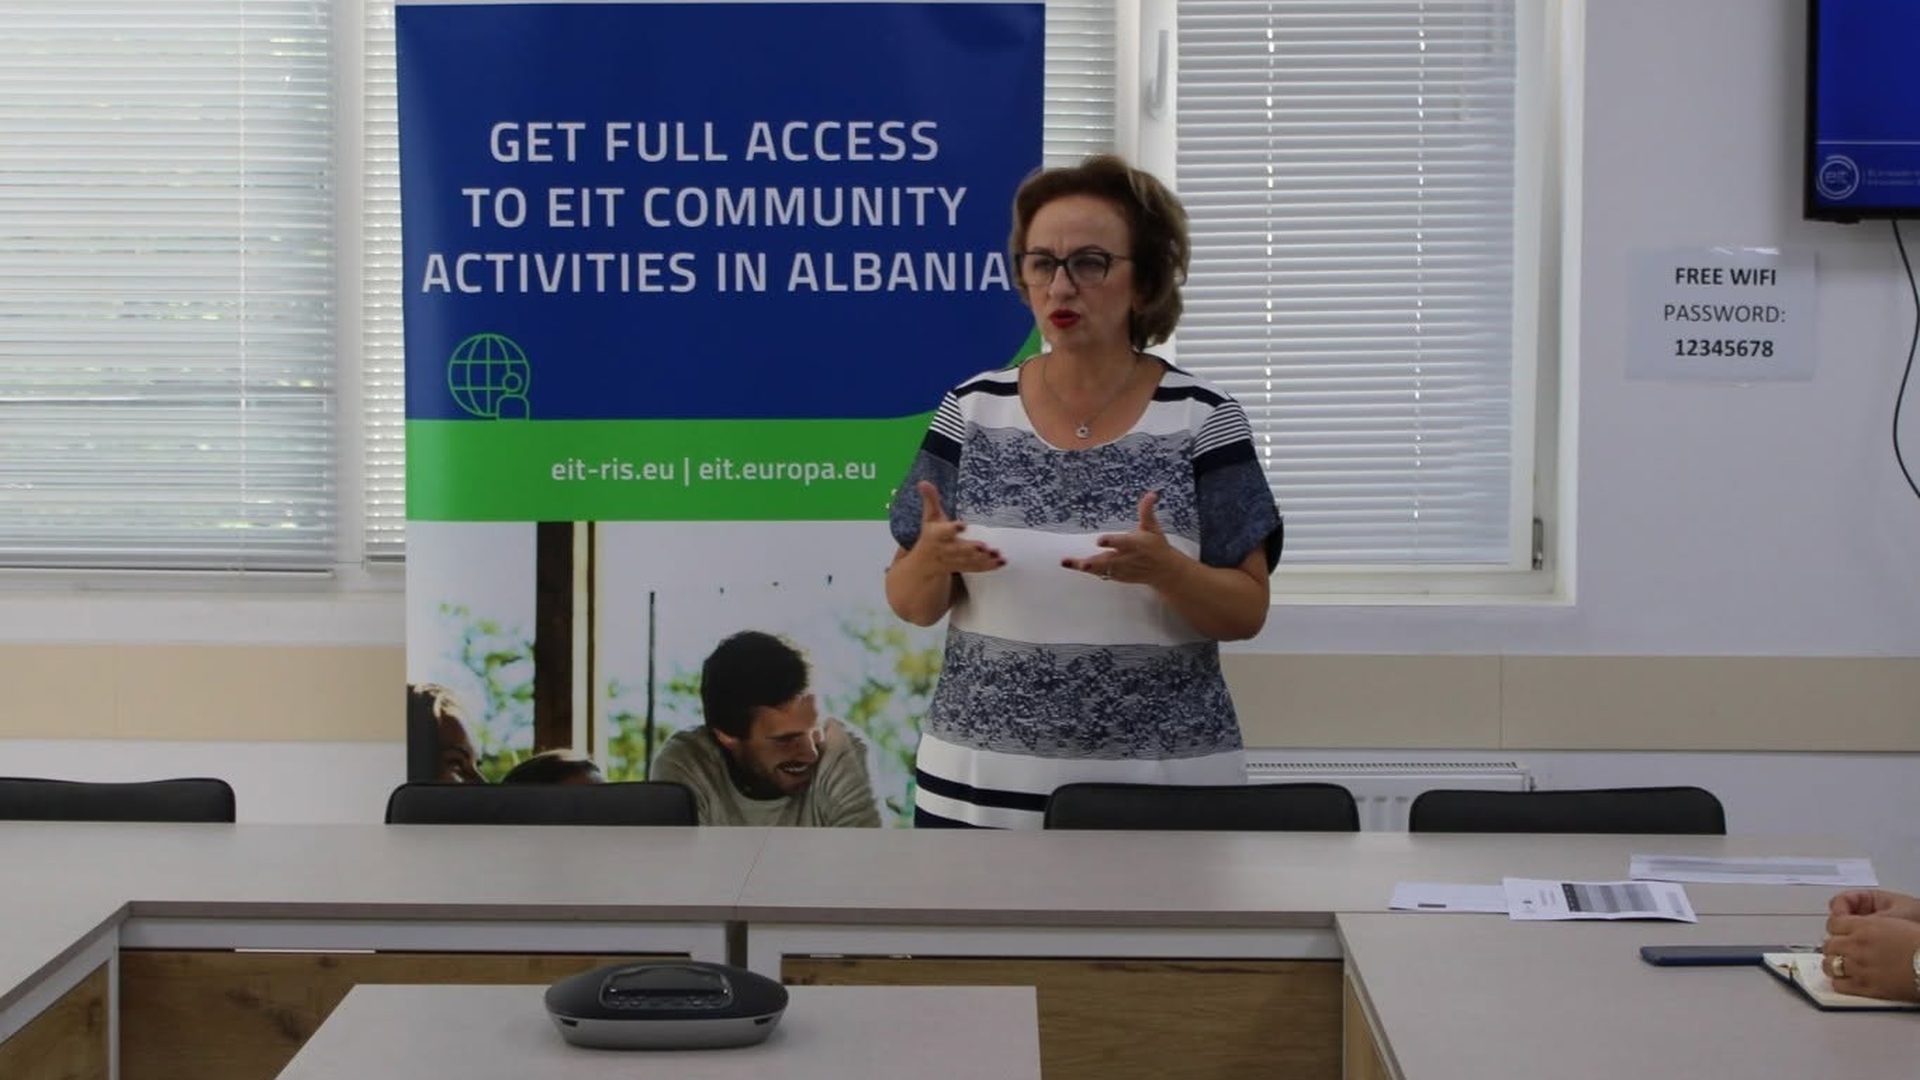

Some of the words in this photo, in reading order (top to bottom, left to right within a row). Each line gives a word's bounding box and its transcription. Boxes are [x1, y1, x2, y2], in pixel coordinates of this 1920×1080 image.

[490, 122, 586, 163] GET
[606, 122, 728, 162] FULL
[746, 121, 938, 162] ACCESS
[462, 187, 527, 228] TO
[548, 187, 625, 227] EIT
[644, 186, 967, 227] COMMUNITY
[421, 252, 696, 293] ACTIVITIES
[718, 252, 766, 292] IN
[788, 252, 1010, 292] ALBANIA
[1675, 267, 1723, 286] FREE
[1730, 268, 1777, 287] WIFI
[1664, 304, 1786, 324] PASSWORD:
[1675, 338, 1774, 358] 12345678
[551, 458, 674, 481] eit-ris.eu
[699, 457, 876, 486] eit.europa.eu
